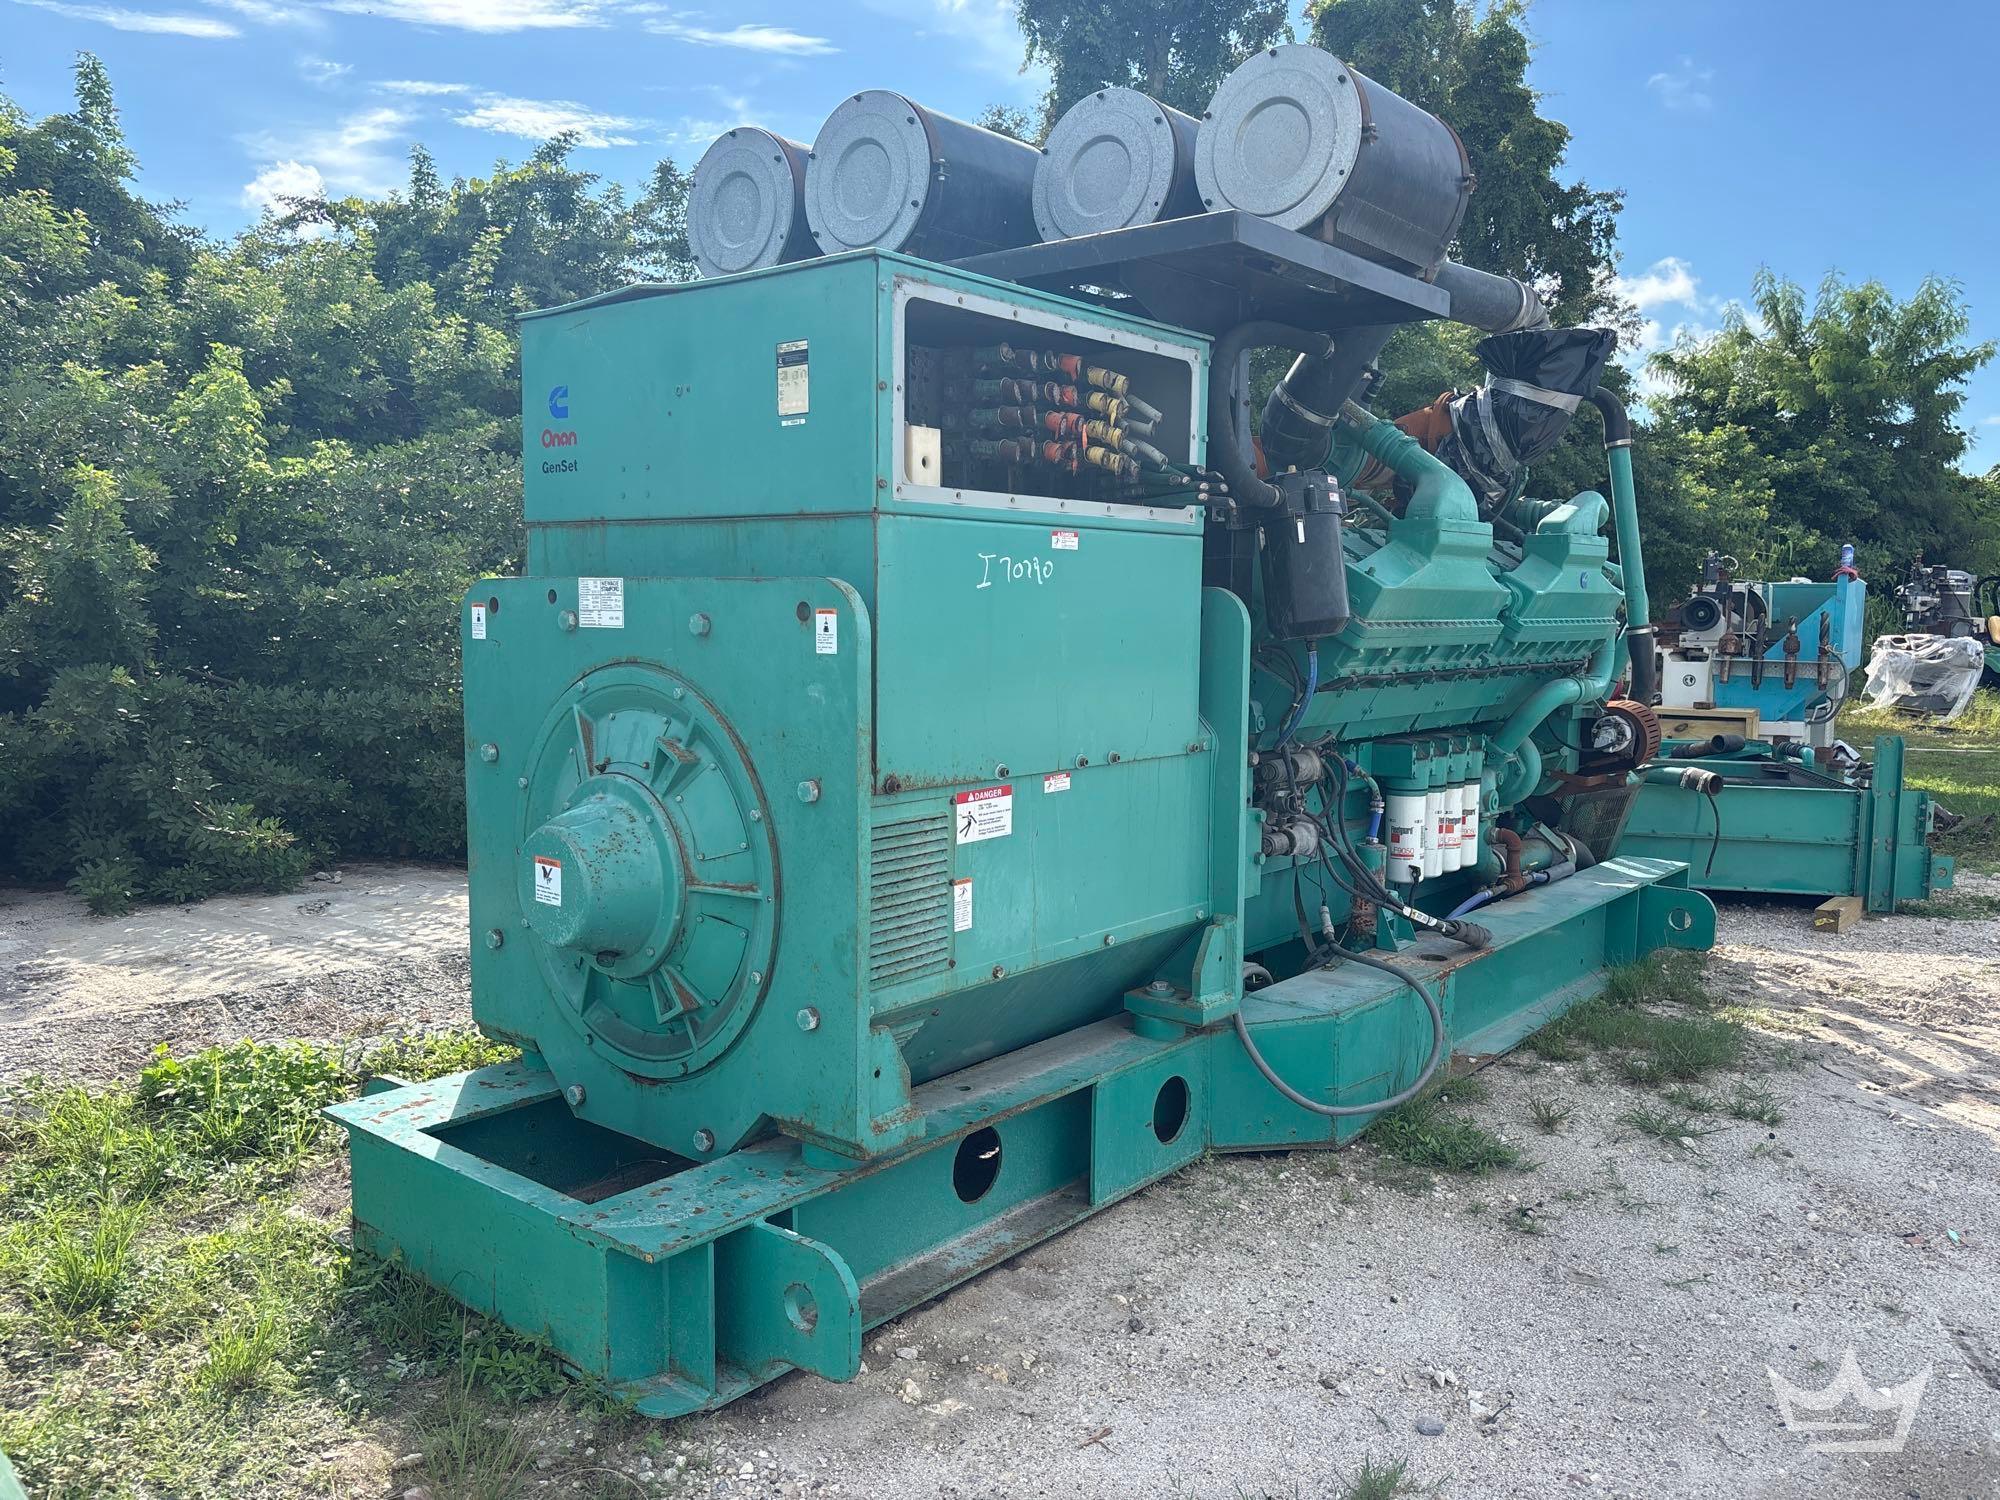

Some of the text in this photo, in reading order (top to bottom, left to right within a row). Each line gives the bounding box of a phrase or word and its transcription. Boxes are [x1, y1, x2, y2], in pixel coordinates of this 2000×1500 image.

[541, 428, 577, 448] Onan
[542, 459, 578, 474] GenSet
[974, 789, 1002, 801] DANGER
[1391, 825, 1414, 836] Fleetguard
